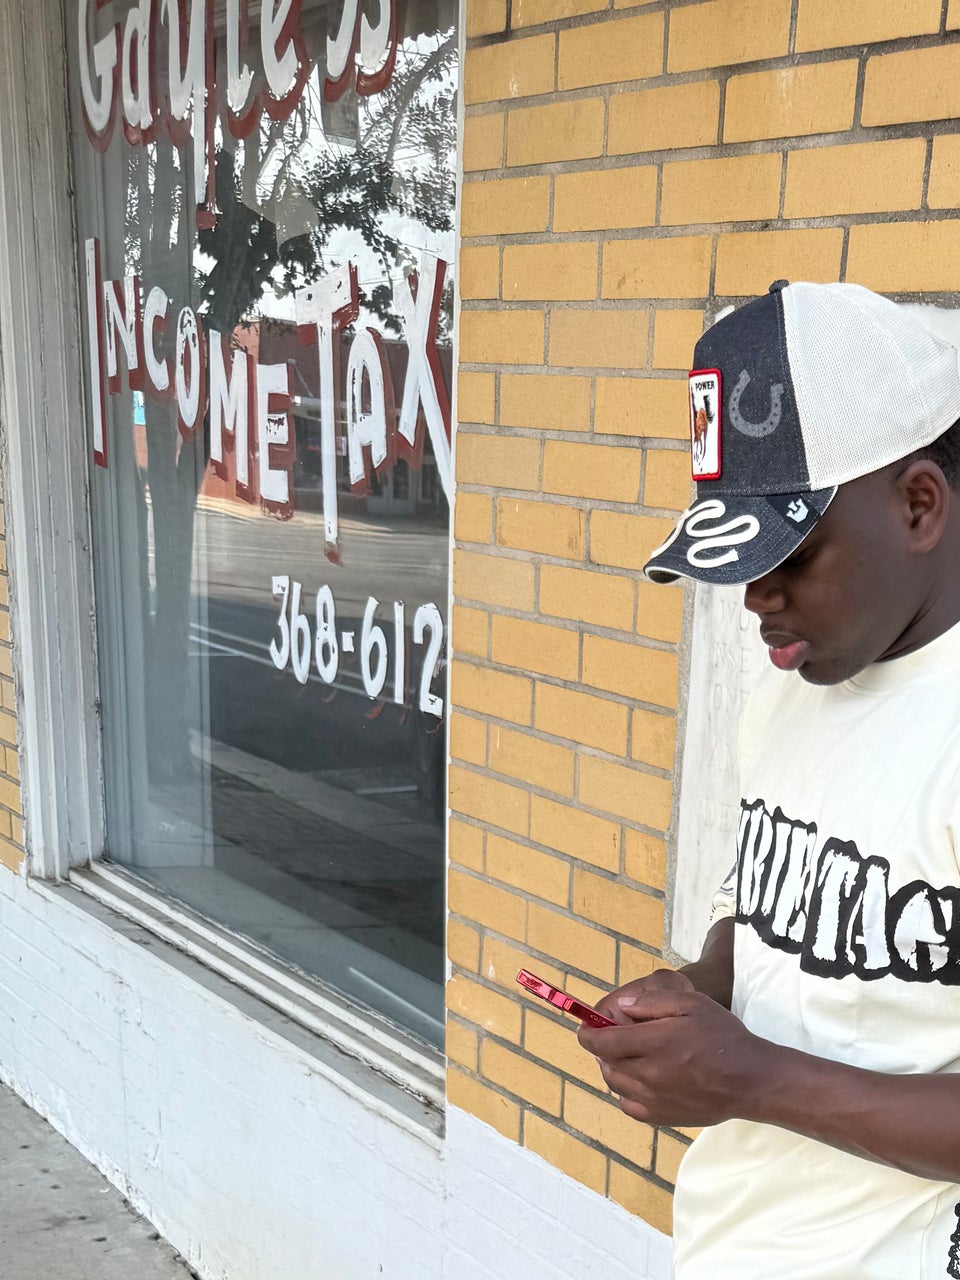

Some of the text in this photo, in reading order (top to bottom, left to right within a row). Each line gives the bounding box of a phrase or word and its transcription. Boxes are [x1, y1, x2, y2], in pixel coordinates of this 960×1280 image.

[86, 238, 451, 545] INCOME TAX
[695, 380, 715, 391] POWER
